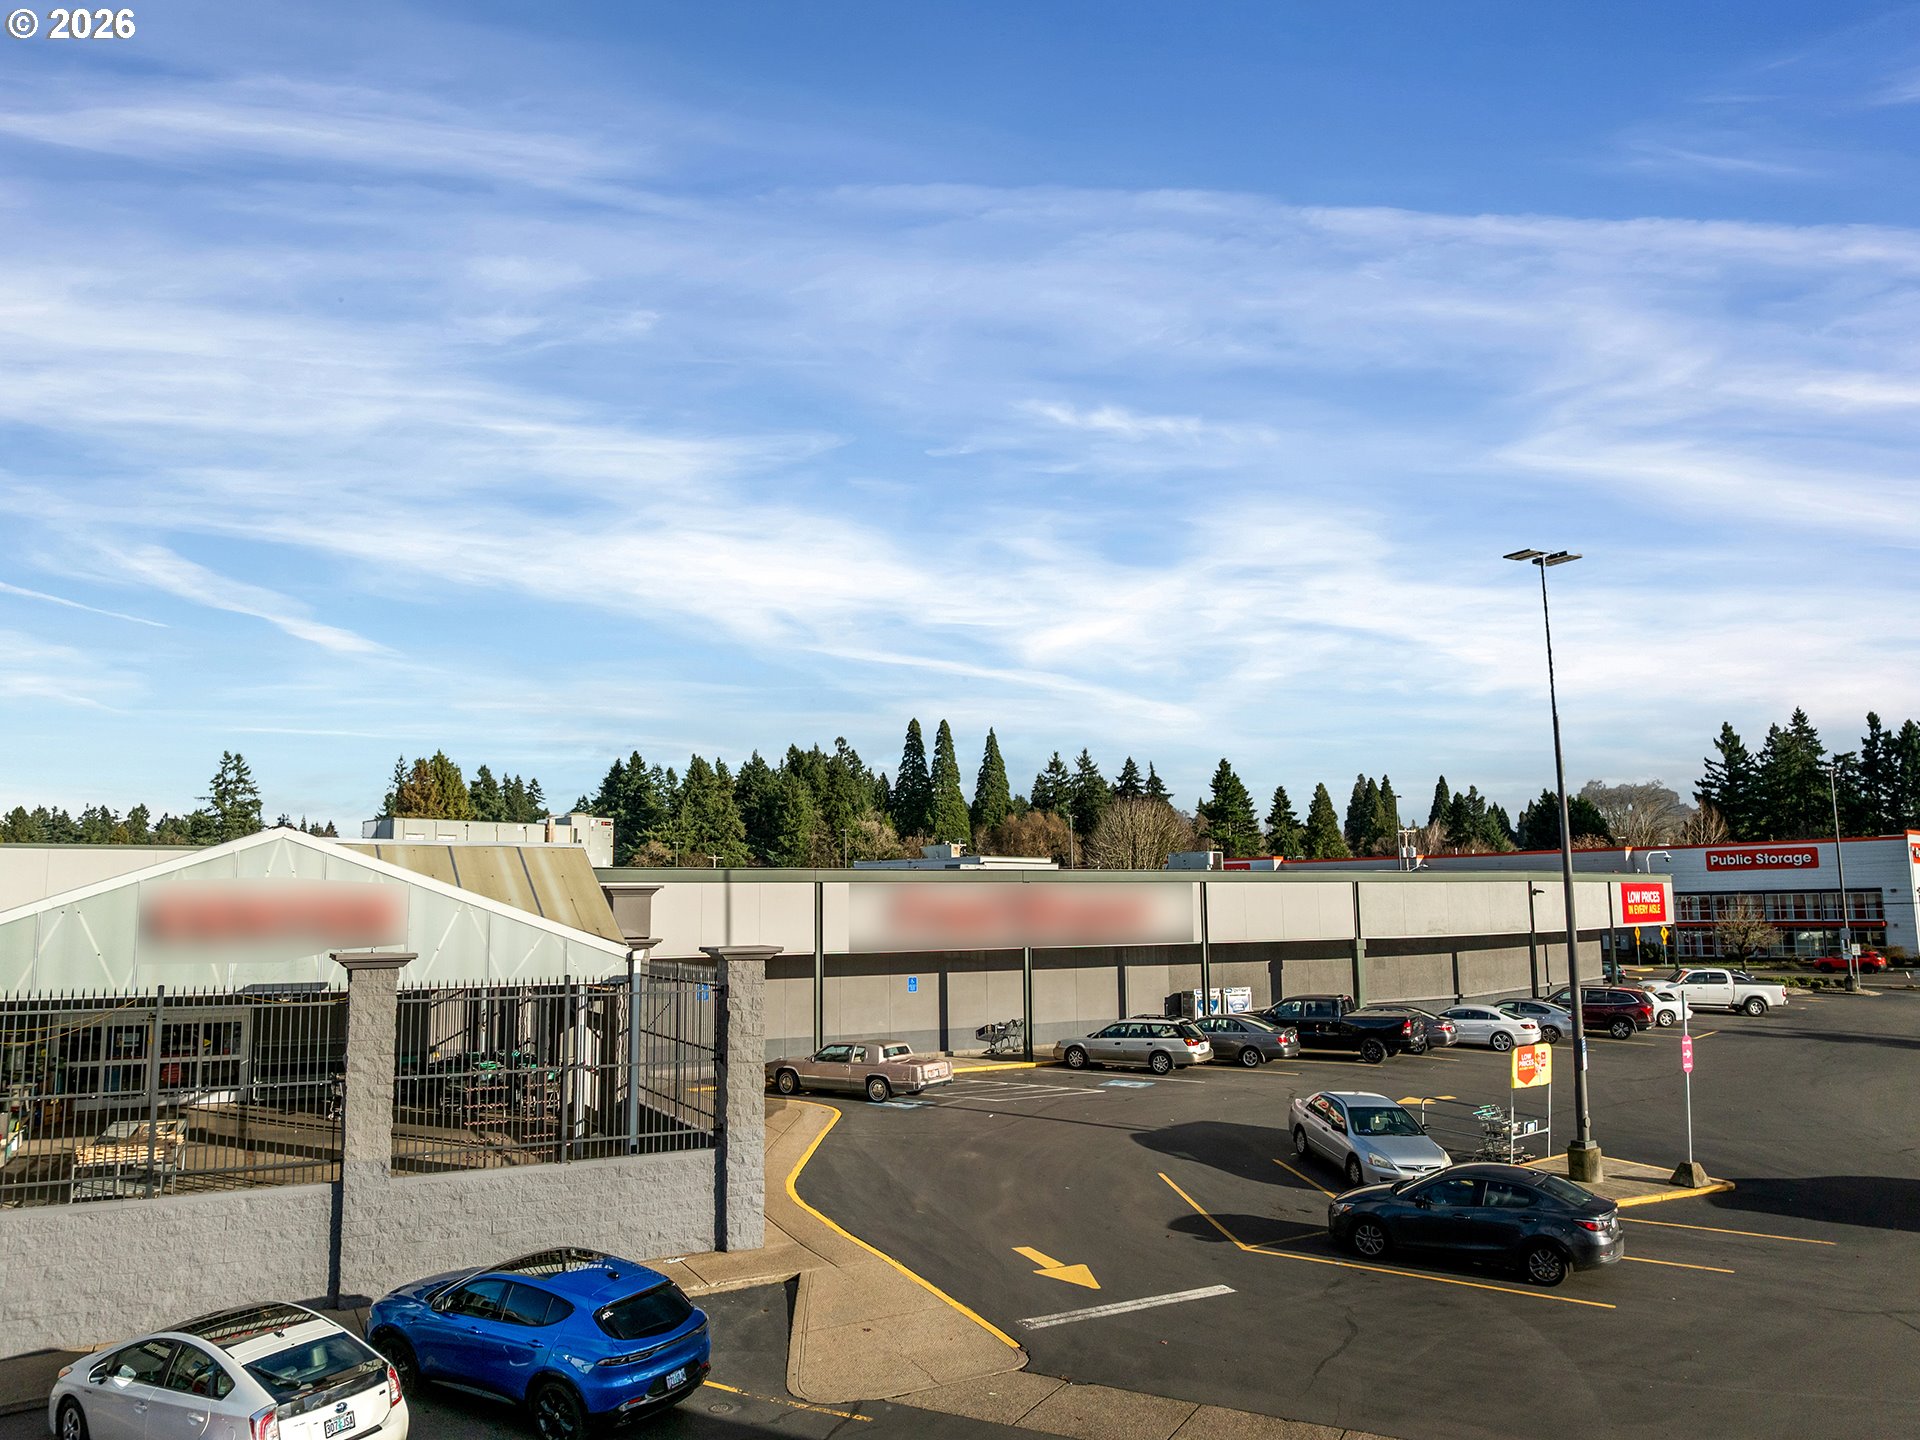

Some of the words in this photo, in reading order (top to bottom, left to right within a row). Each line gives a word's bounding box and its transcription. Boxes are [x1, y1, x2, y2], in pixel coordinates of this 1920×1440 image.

[1710, 854, 1752, 866] Public
[1755, 853, 1812, 866] Storage
[1627, 891, 1641, 903] LOW
[1641, 891, 1660, 903] PRICES
[1628, 905, 1634, 914] IN
[1634, 904, 1648, 914] EVERY
[1649, 904, 1661, 914] AISLE
[1521, 1053, 1532, 1061] LOW
[327, 1421, 338, 1433] 307
